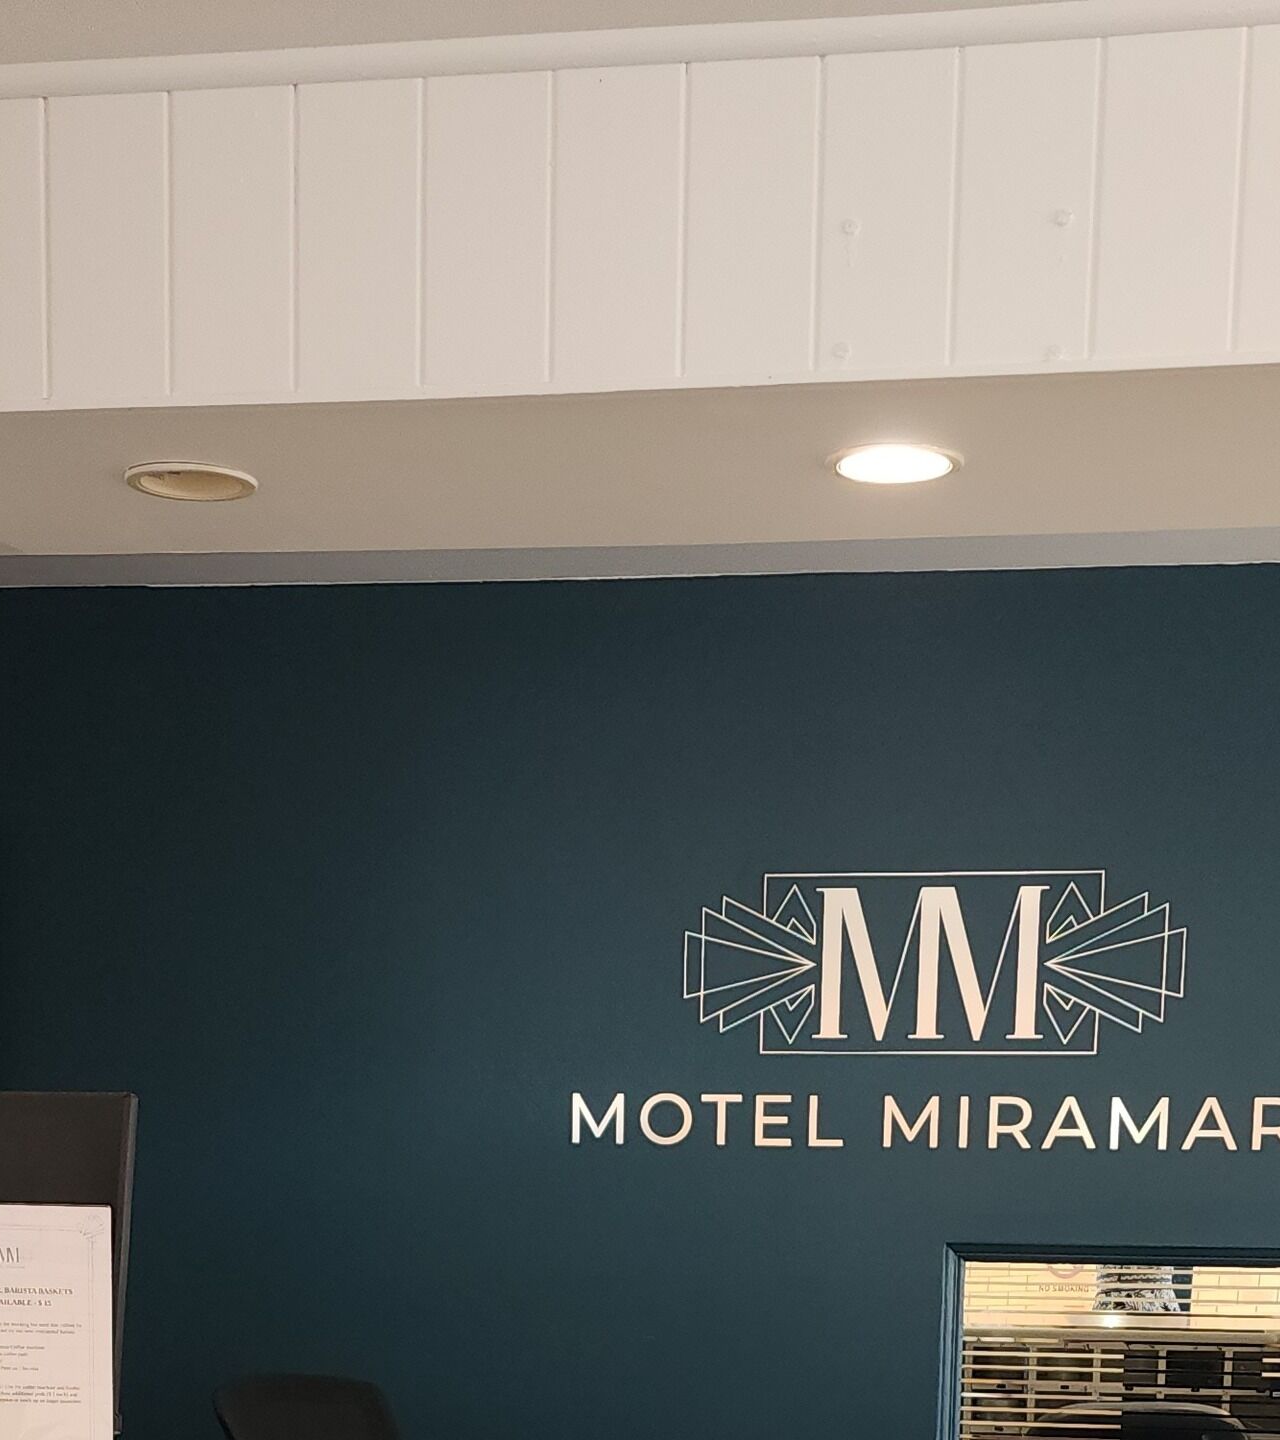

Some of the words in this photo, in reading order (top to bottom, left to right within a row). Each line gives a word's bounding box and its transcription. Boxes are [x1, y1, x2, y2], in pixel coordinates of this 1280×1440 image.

[811, 885, 1050, 1042] MM
[570, 1092, 844, 1148] MOTEL
[4, 1287, 37, 1295] BARISTA
[38, 1287, 74, 1295] BASKETS
[1038, 1284, 1051, 1293] NO
[1051, 1285, 1090, 1294] SMOKING
